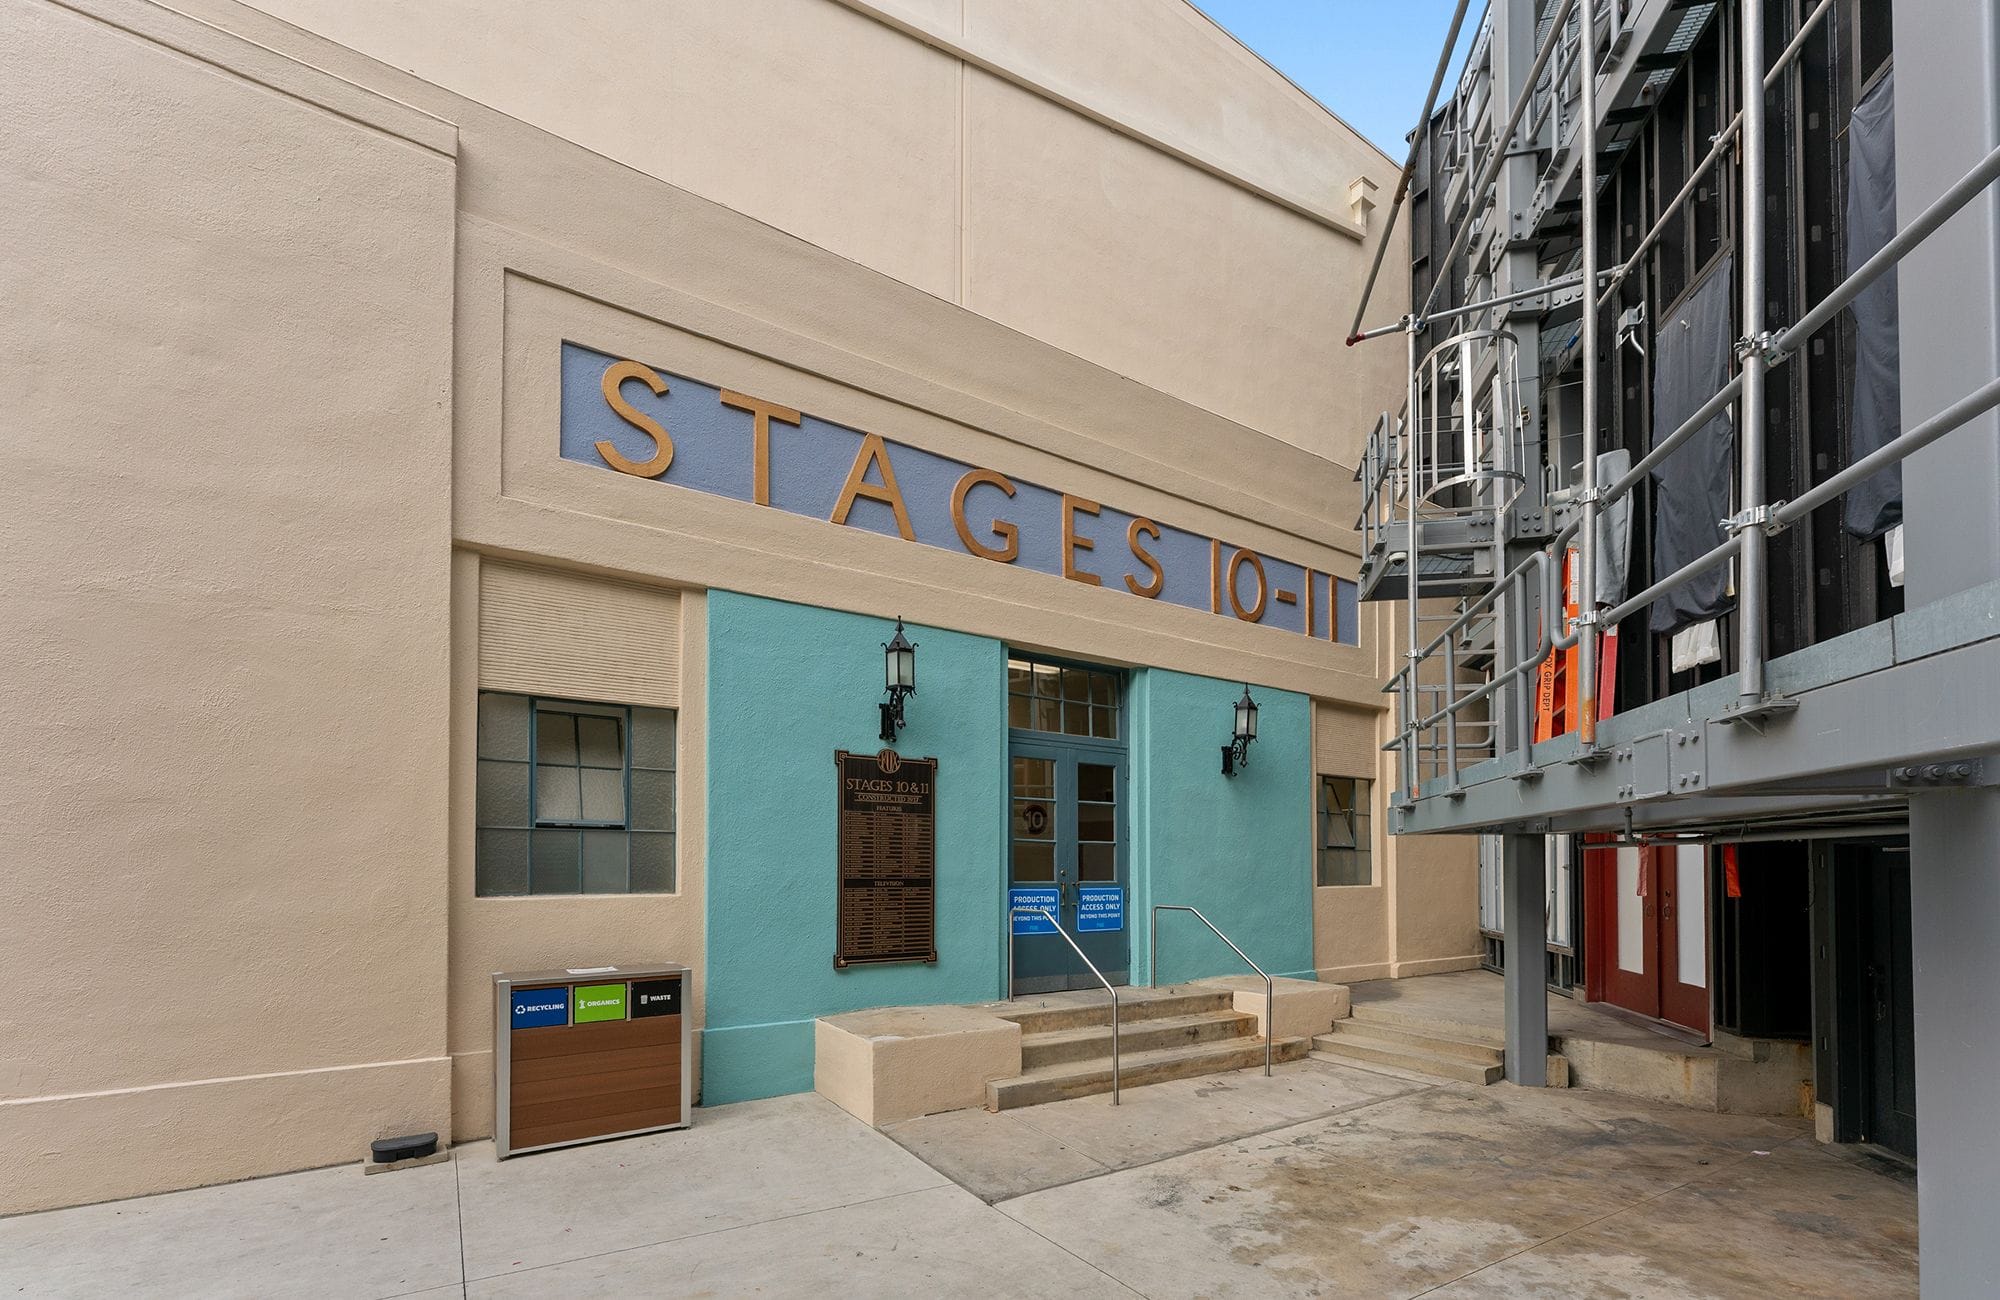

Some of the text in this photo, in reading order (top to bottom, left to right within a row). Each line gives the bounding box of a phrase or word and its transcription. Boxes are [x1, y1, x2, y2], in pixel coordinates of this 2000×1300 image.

[594, 360, 1338, 642] STAGES 10-11
[1544, 671, 1552, 690] GRIP
[1543, 692, 1551, 711] DEPT
[846, 778, 893, 792] STAGES
[897, 781, 909, 793] 10
[1025, 810, 1043, 829] 10
[1014, 895, 1055, 904] PRODUCTION
[1082, 894, 1119, 902] PRODUCTION
[1081, 903, 1104, 911] ACCESS
[587, 999, 620, 1007] ORGANICS
[650, 994, 671, 1002] WASTE
[527, 1003, 565, 1013] RECYCLING
